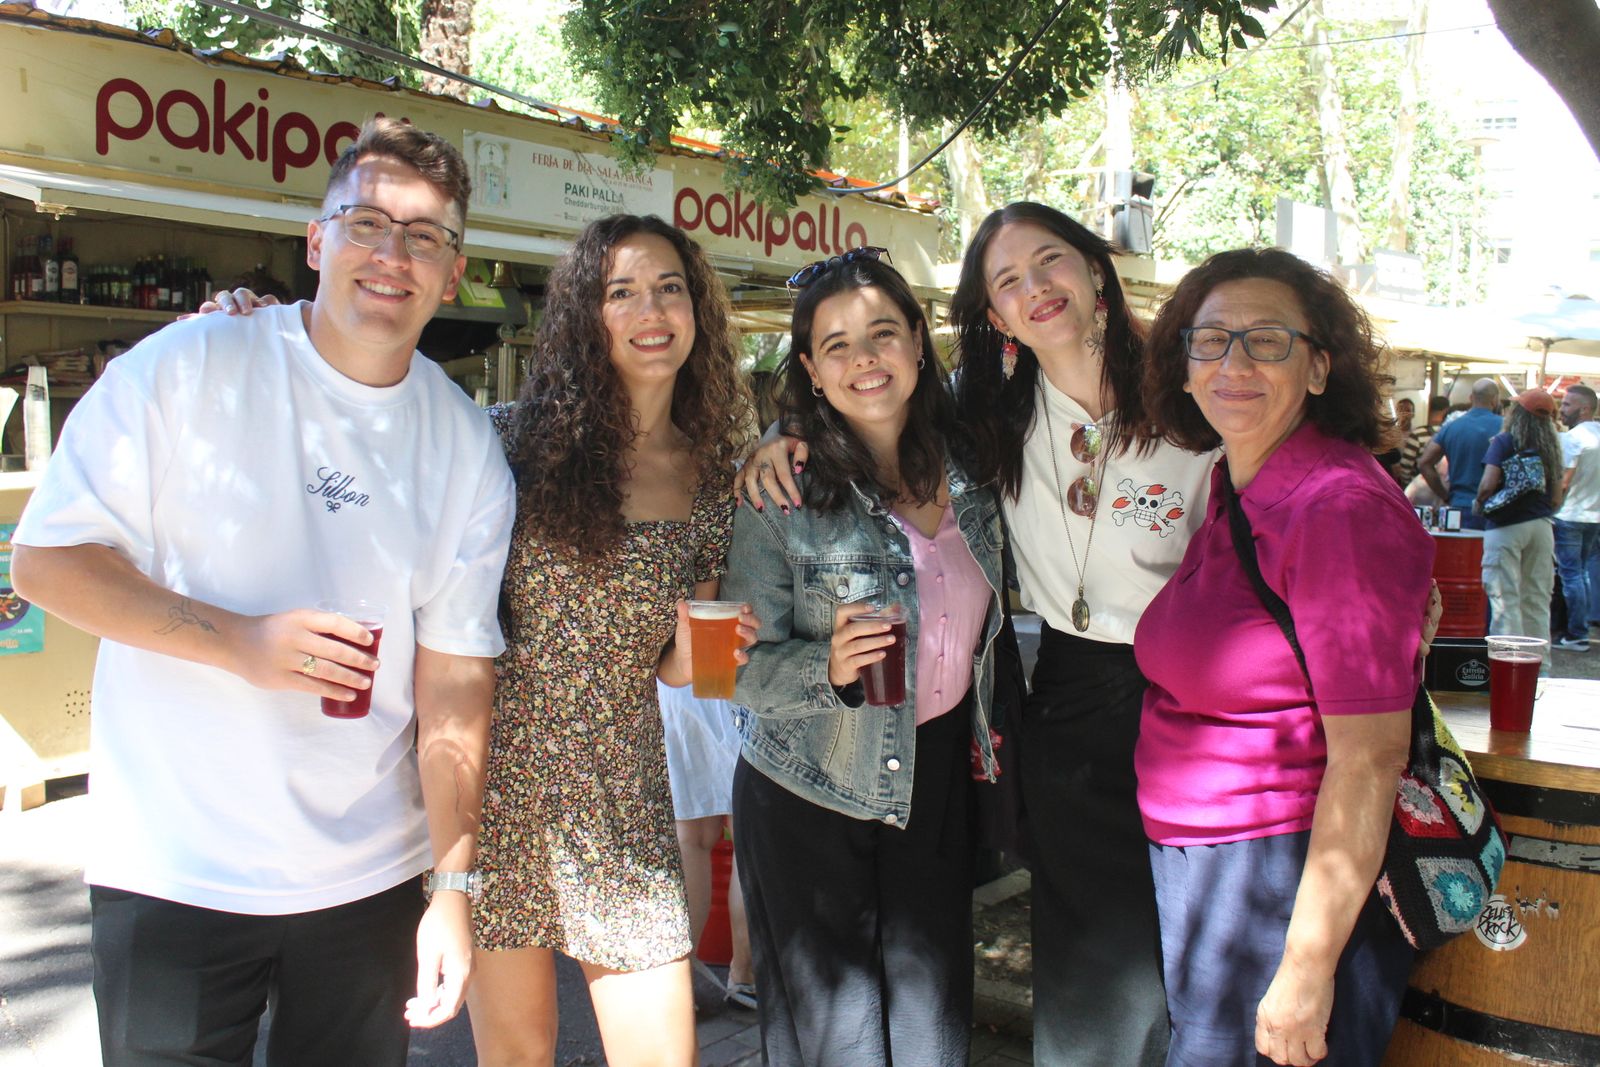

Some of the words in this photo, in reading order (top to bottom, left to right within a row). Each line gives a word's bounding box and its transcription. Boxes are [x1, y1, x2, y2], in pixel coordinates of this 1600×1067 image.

[96, 78, 410, 183] pakip
[564, 182, 589, 198] PAKI
[592, 188, 624, 203] PALLA
[306, 466, 370, 507] Silbon
